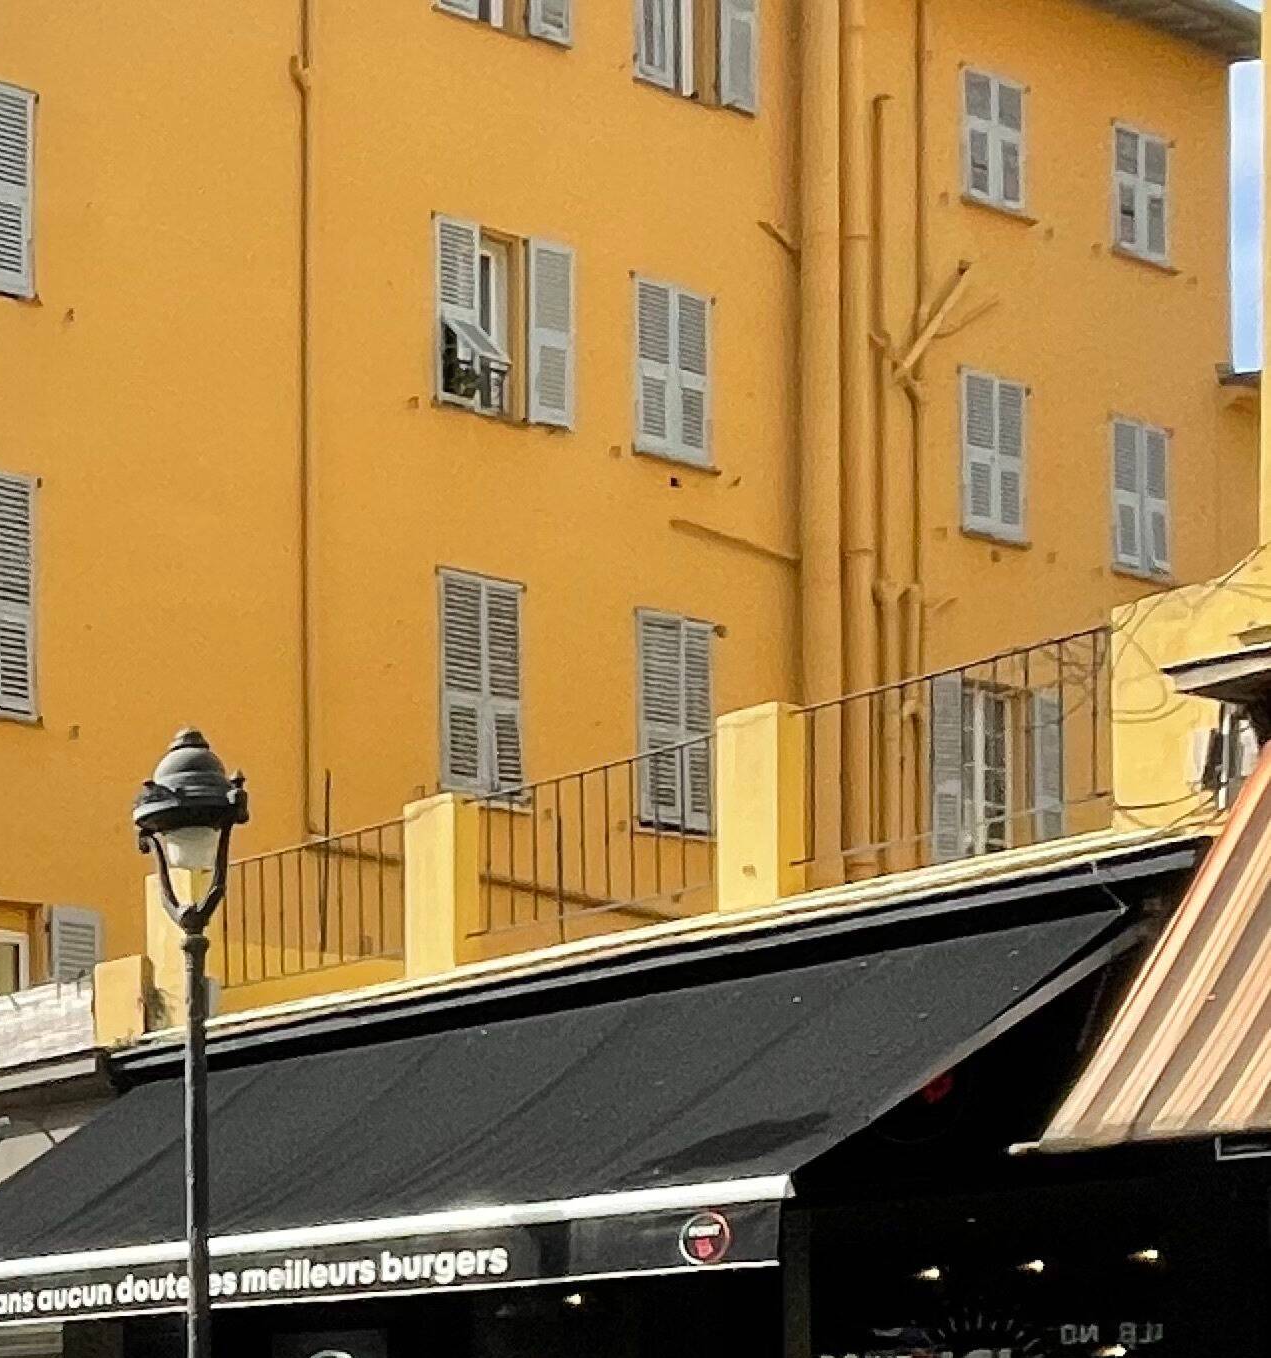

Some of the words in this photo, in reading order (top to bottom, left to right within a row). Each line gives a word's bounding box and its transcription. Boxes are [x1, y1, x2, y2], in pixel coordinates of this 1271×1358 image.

[36, 1283, 112, 1312] aucun
[209, 1271, 238, 1296] es
[241, 1257, 376, 1294] meilleurs
[381, 1247, 508, 1285] burgers
